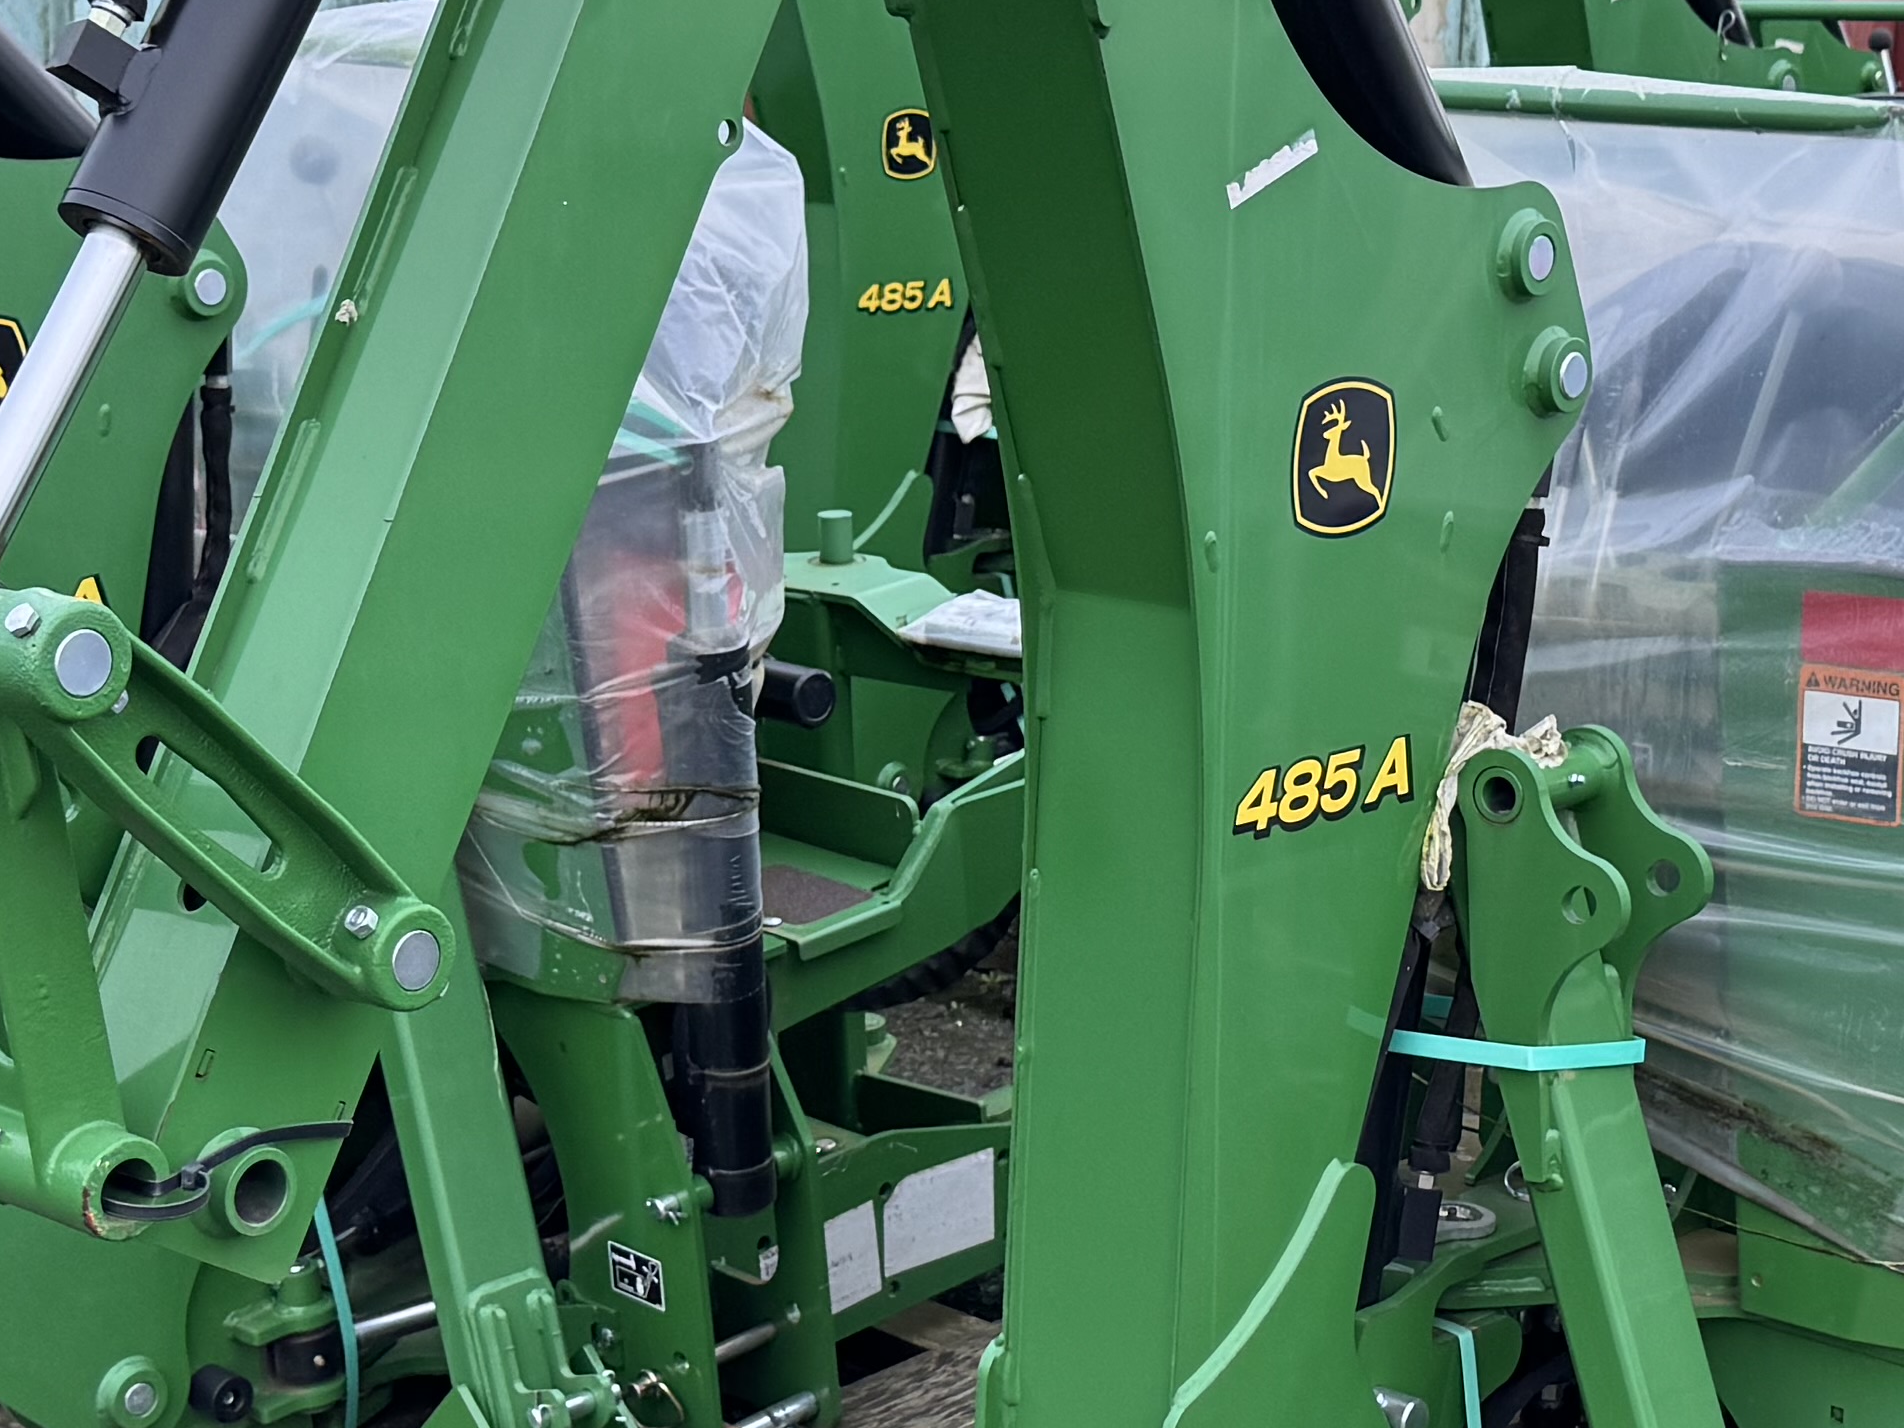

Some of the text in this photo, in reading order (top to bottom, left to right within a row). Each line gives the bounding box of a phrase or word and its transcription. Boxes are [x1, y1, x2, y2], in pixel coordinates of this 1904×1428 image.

[858, 277, 953, 313] 485 A
[1823, 674, 1900, 697] WARNING
[1234, 735, 1412, 836] 485 A
